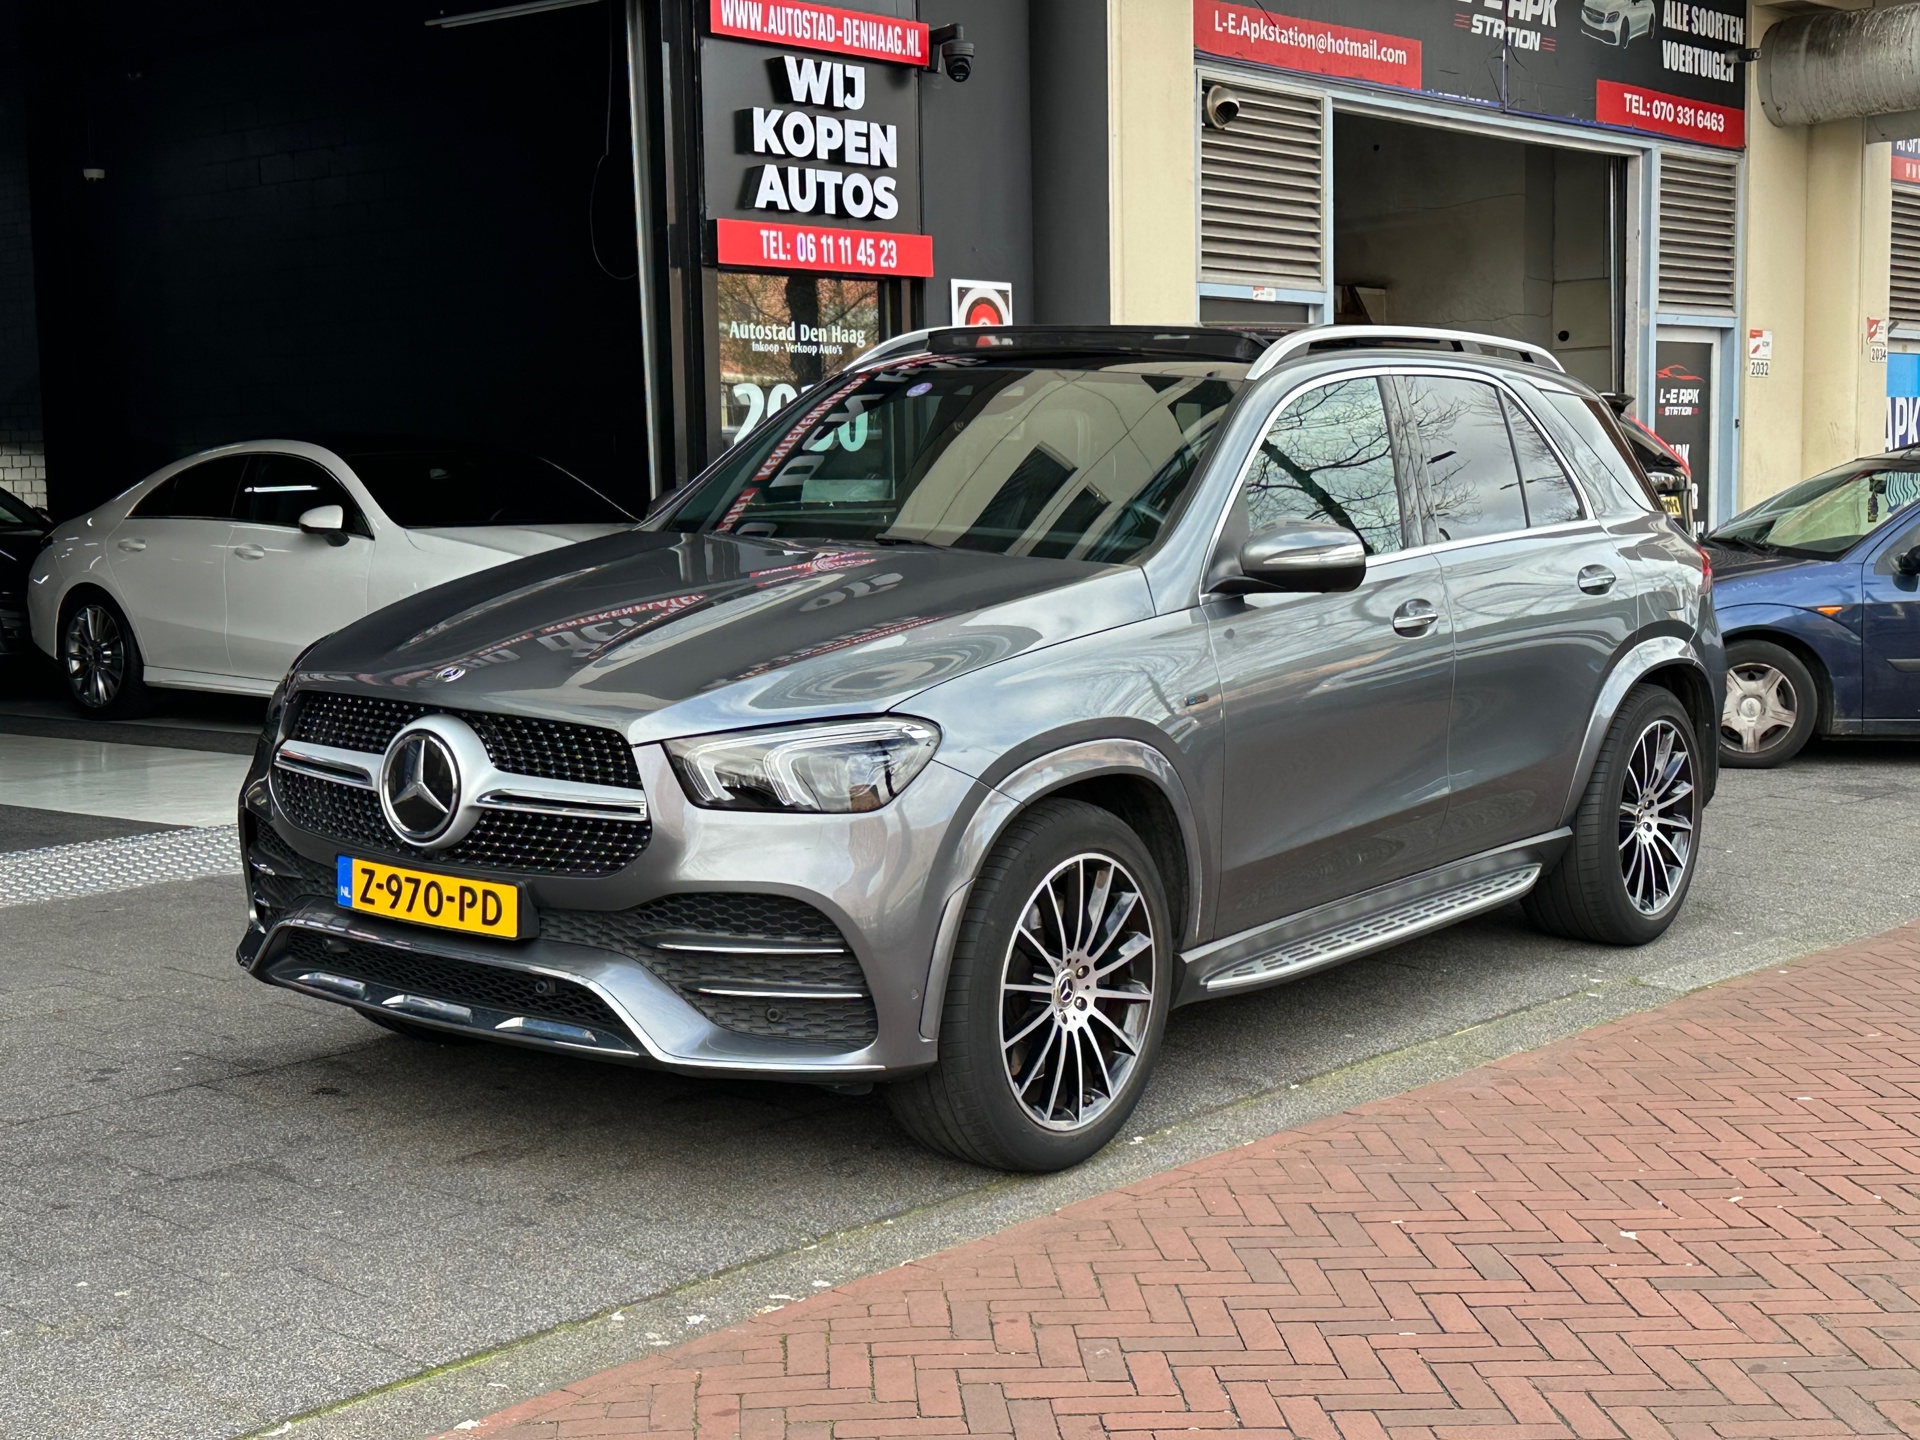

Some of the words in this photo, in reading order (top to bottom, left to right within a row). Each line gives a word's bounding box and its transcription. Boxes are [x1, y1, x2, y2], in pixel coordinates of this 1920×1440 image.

[721, 1, 922, 57] WWW.AUTOSTAD-DENHAAG.NL
[1214, 10, 1407, 65] L-E.Apkstation@hotmail.com
[1471, 14, 1541, 51] STATION
[1662, 0, 1690, 33] ALLE
[1691, 6, 1744, 45] SOORTEN
[783, 55, 866, 110] WIJ
[1623, 93, 1651, 117] TEL:
[1652, 100, 1675, 123] 070
[1676, 106, 1695, 127] 331
[1696, 109, 1725, 133] 6463
[752, 107, 898, 168] KOPEN
[754, 164, 899, 220] AUTOS
[760, 230, 791, 261] TEL:
[796, 232, 817, 263] 06
[820, 236, 835, 264] 11
[838, 236, 852, 265] 11
[856, 238, 876, 268] 45
[879, 239, 898, 268] 23
[729, 321, 796, 342] Autostad
[800, 324, 828, 342] Den
[831, 325, 866, 348] Haag
[752, 341, 780, 355] Inkoop
[785, 343, 818, 356] Verkoop
[818, 344, 843, 355] Auto's
[1751, 361, 1769, 376] 2032
[1659, 388, 1679, 404] L-E
[1678, 388, 1700, 404] APK
[340, 886, 351, 898] NL
[360, 867, 503, 927] Z-970-PD
